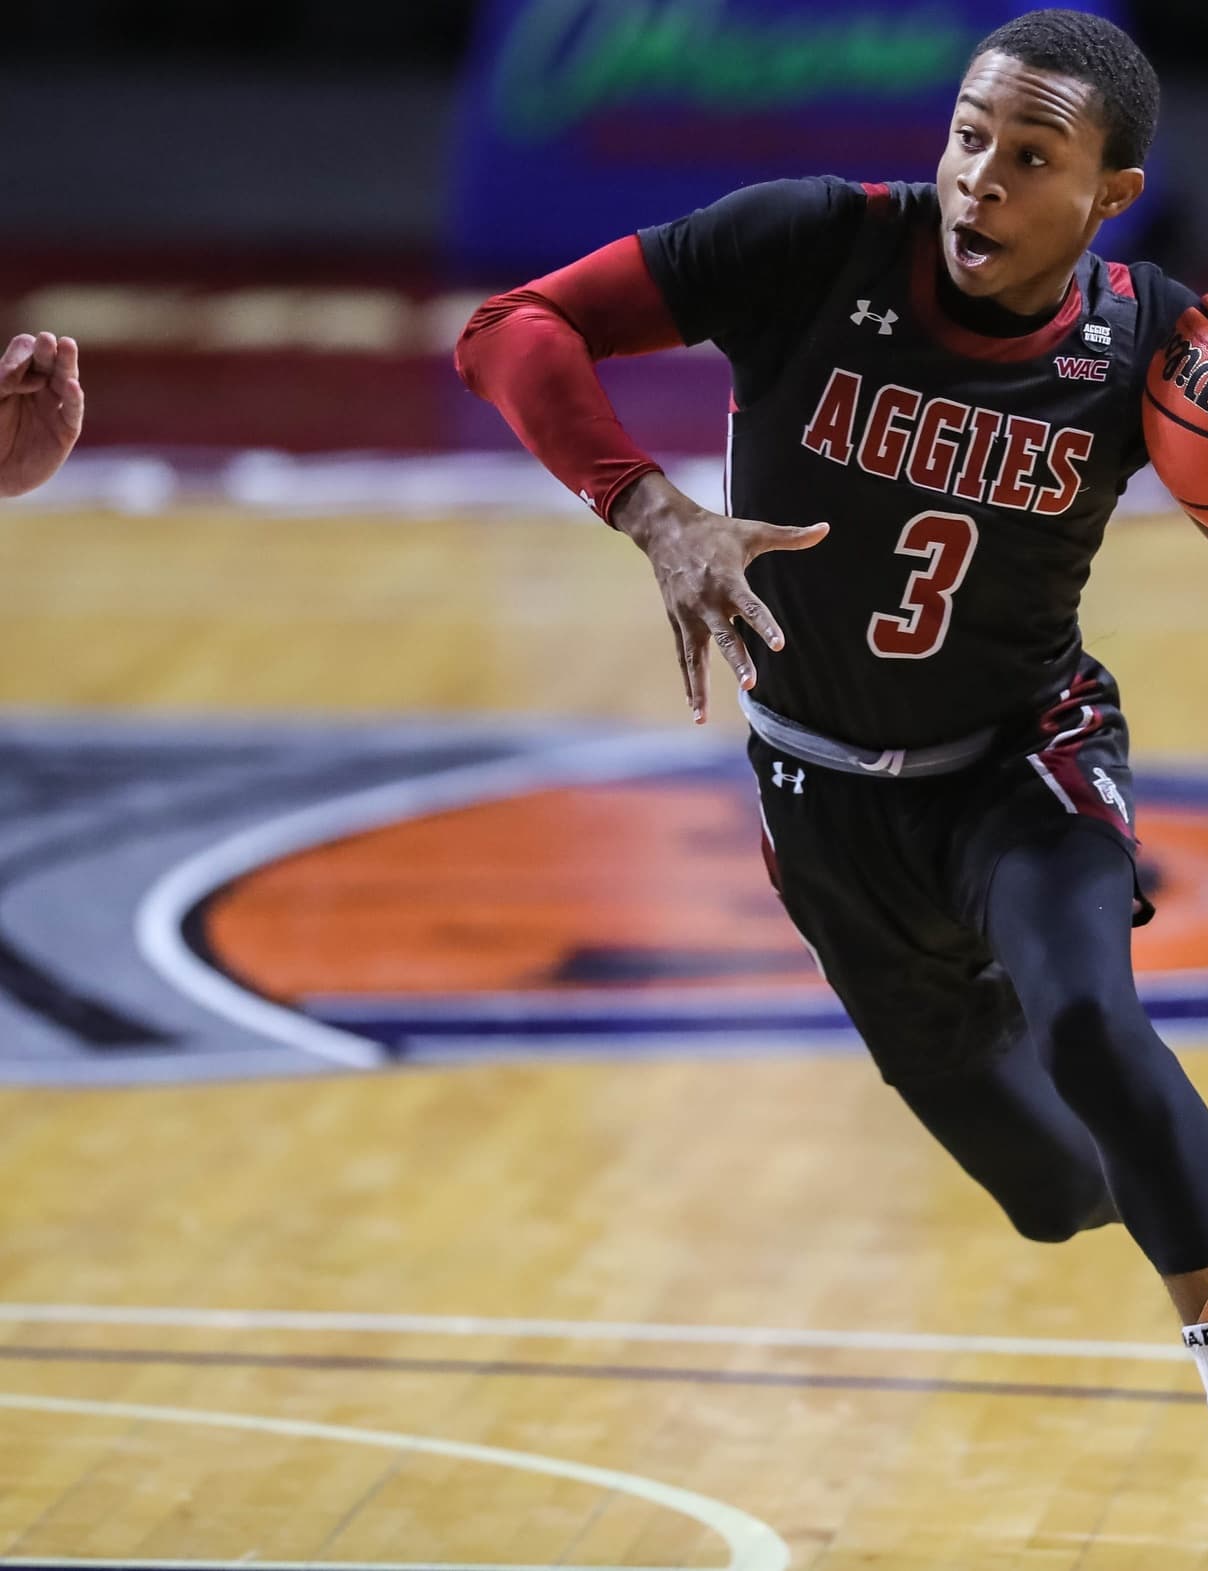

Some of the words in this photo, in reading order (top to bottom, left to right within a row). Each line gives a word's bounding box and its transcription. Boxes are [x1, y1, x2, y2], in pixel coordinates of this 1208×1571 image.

[1053, 356, 1110, 382] WAC
[1083, 323, 1111, 337] AGGIES
[801, 367, 1094, 515] AGGIES
[866, 510, 979, 659] 3
